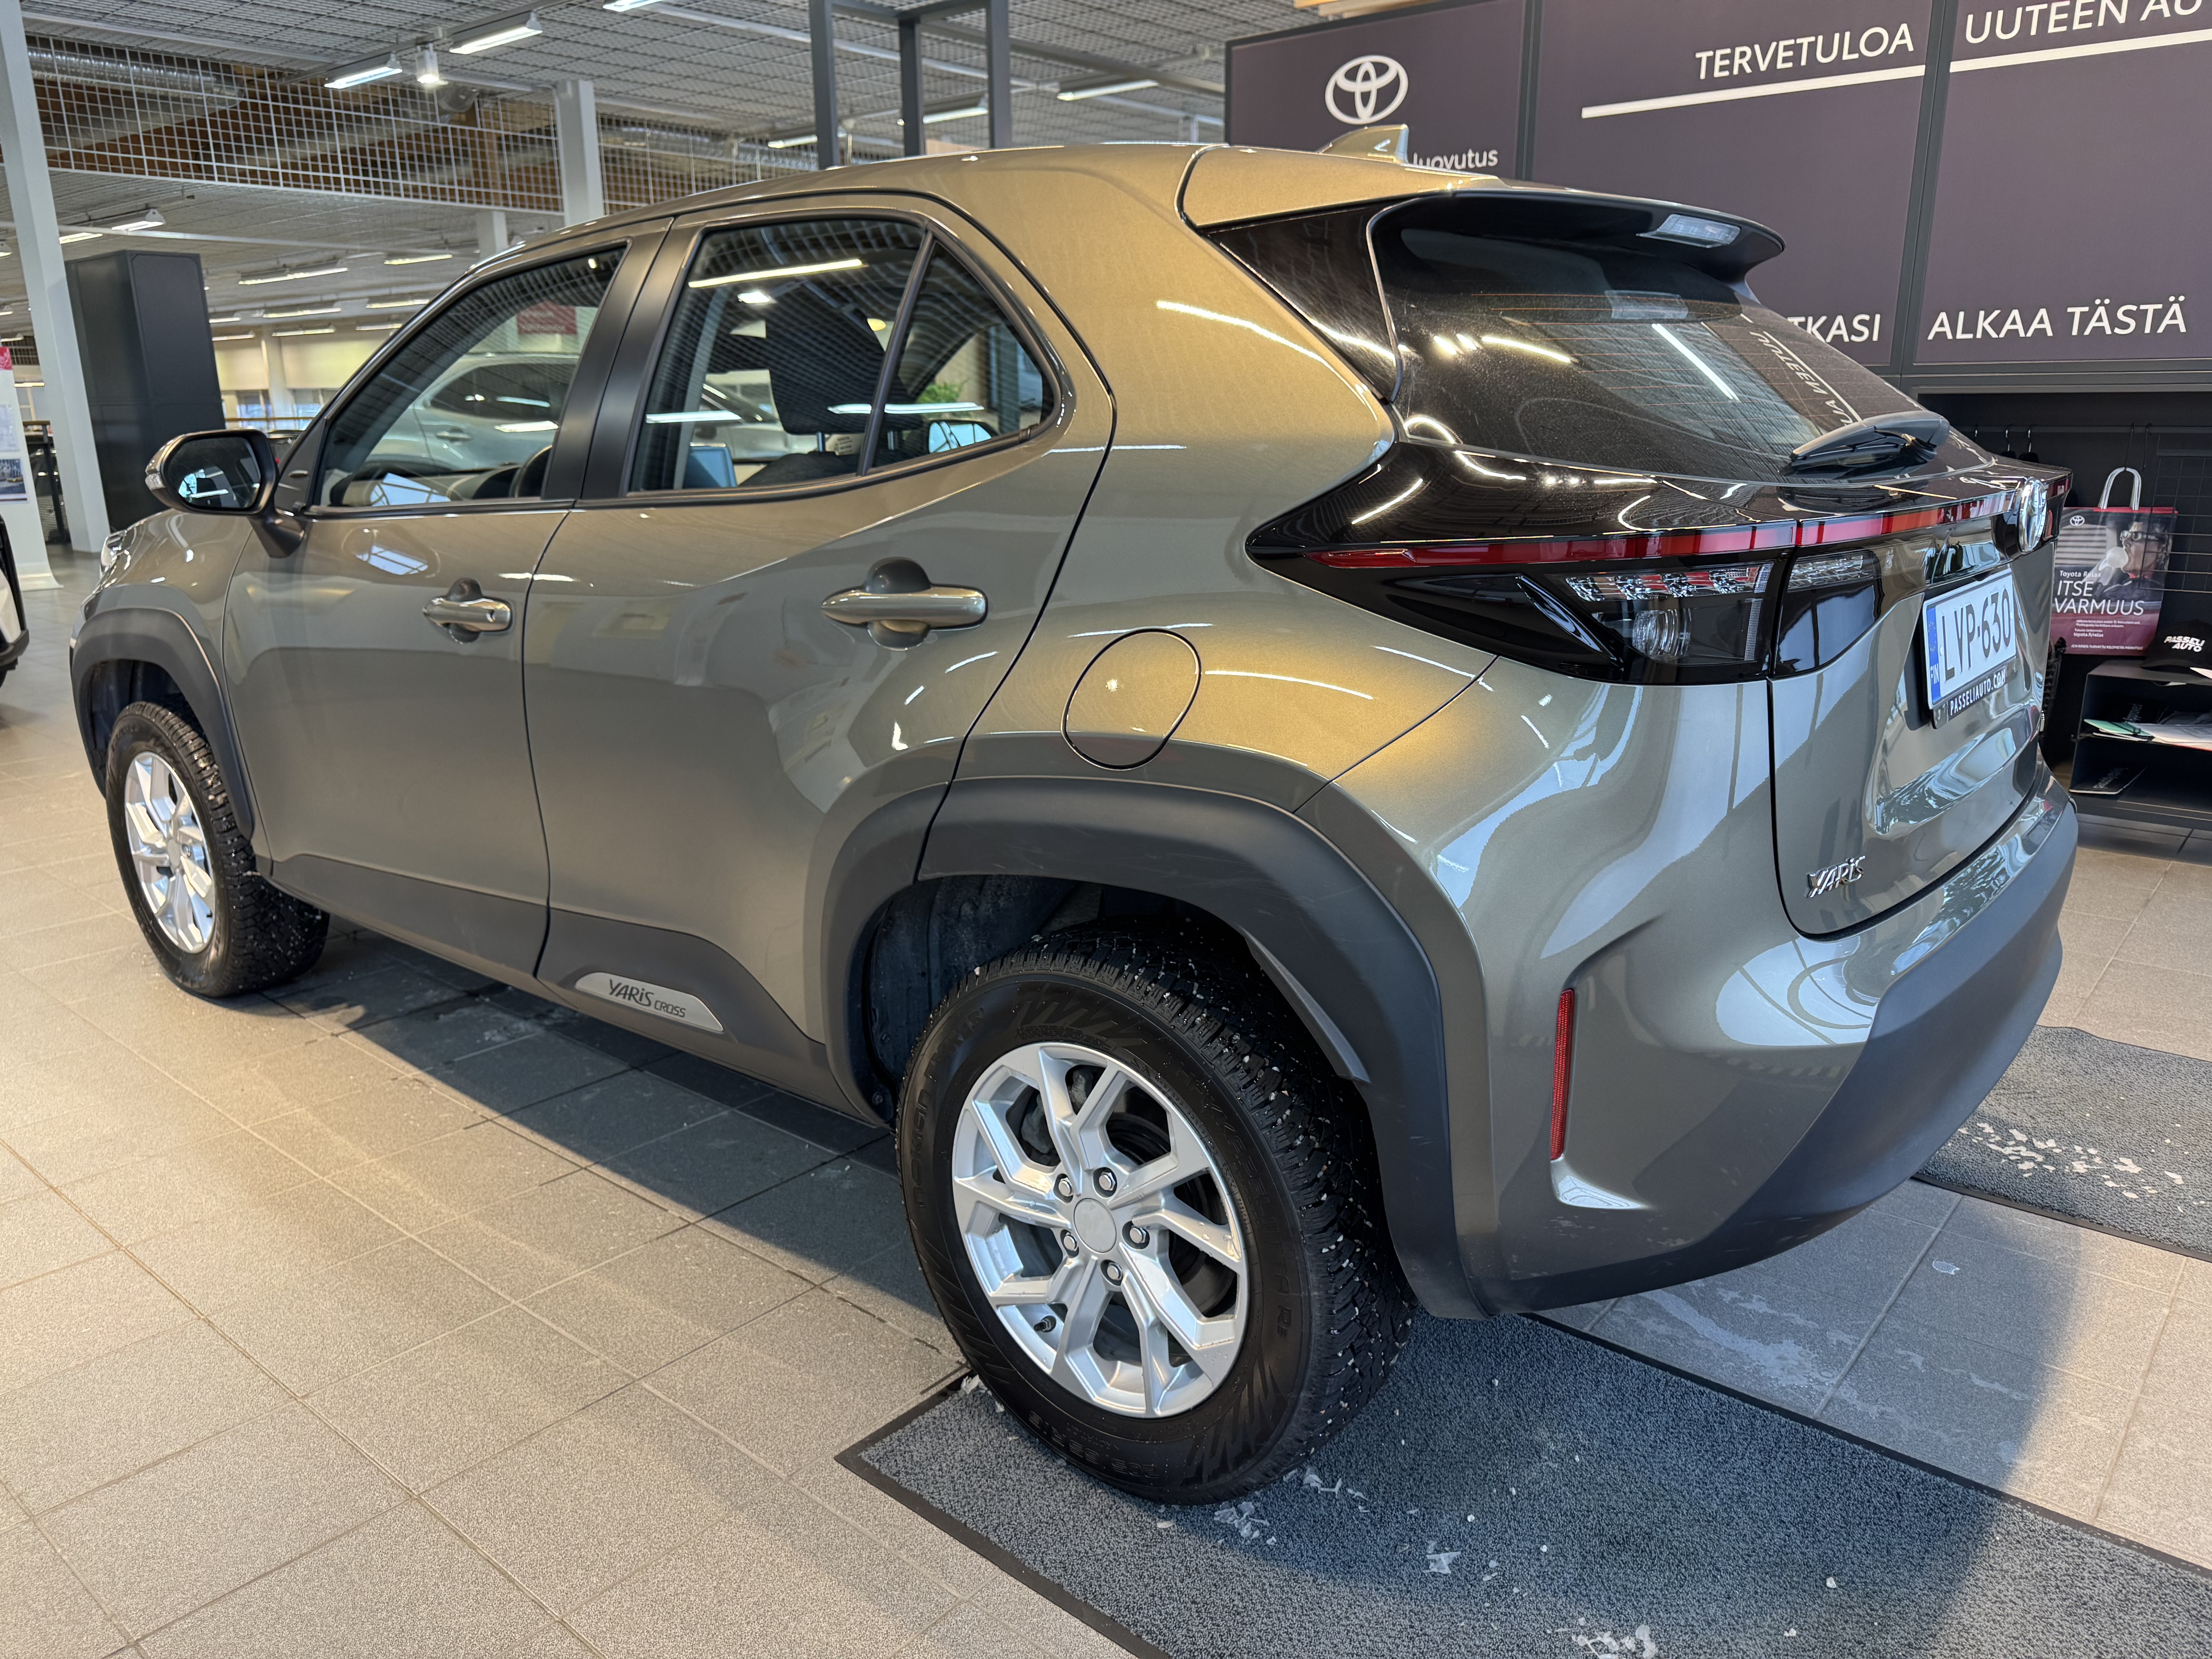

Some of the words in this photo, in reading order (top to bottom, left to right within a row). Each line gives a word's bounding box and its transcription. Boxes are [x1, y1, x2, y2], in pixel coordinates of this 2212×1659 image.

[1966, 0, 2128, 43] UUTEEN
[1695, 23, 1914, 79] TERVETULOA
[1927, 308, 2053, 341] ALKAA
[2067, 295, 2187, 335] TÄSTÄ
[2060, 570, 2081, 579] Toyota
[2057, 580, 2094, 596] ITSE
[2054, 598, 2145, 616] VARMUUS
[1942, 588, 2011, 683] LVP-630
[2164, 636, 2205, 646] PASSELI
[2172, 642, 2202, 652] AUTO
[1930, 663, 1940, 684] FIN
[1950, 668, 2006, 716] PASSELIAUTO.COM
[654, 1000, 687, 1018] CROSS
